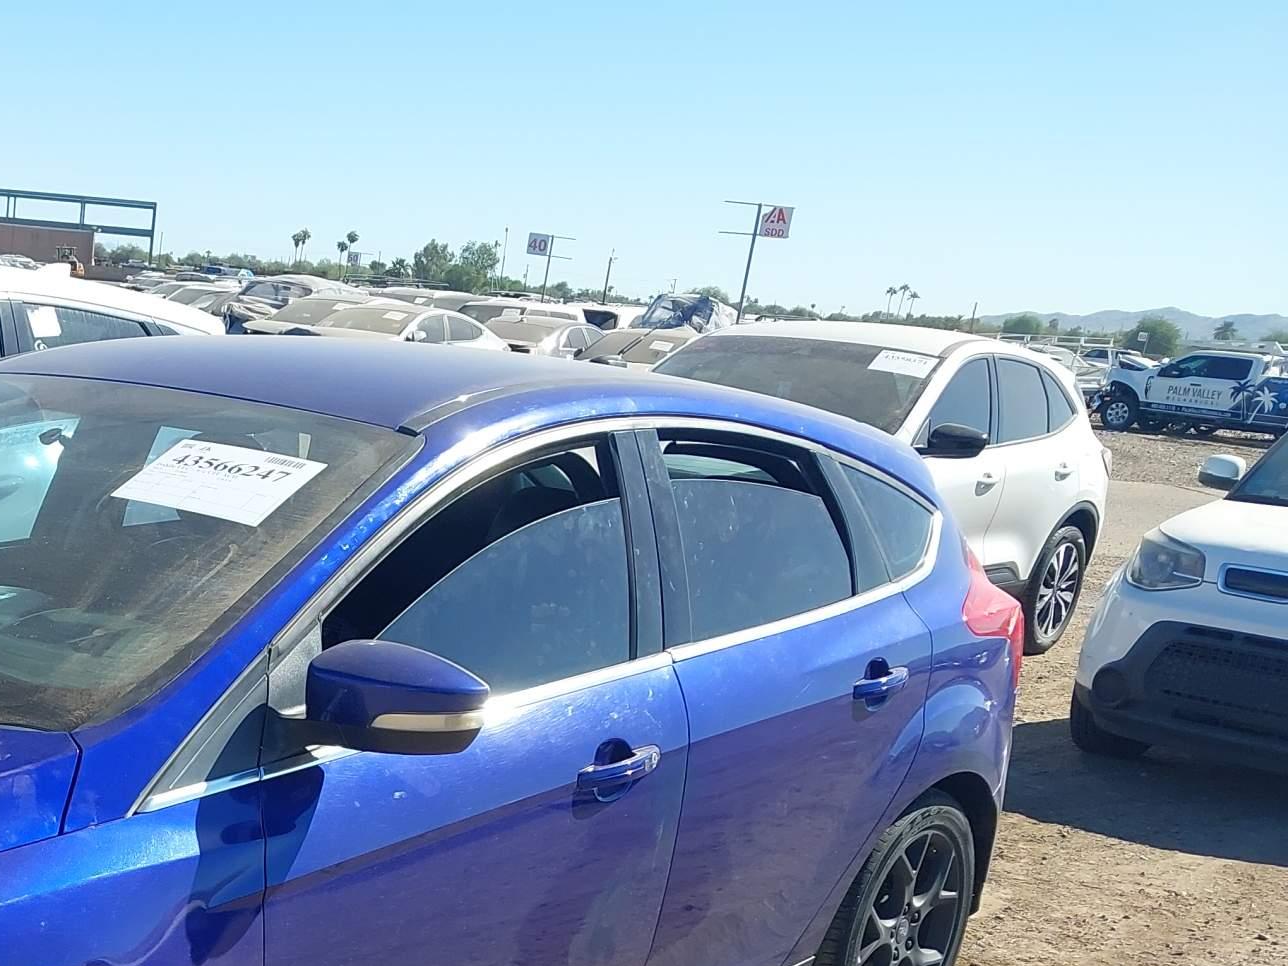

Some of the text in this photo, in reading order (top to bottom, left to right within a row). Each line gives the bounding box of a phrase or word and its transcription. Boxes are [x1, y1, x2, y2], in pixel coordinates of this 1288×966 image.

[528, 238, 547, 252] 40
[1167, 385, 1224, 401] PALM VALLEY
[172, 454, 293, 483] 43566247
